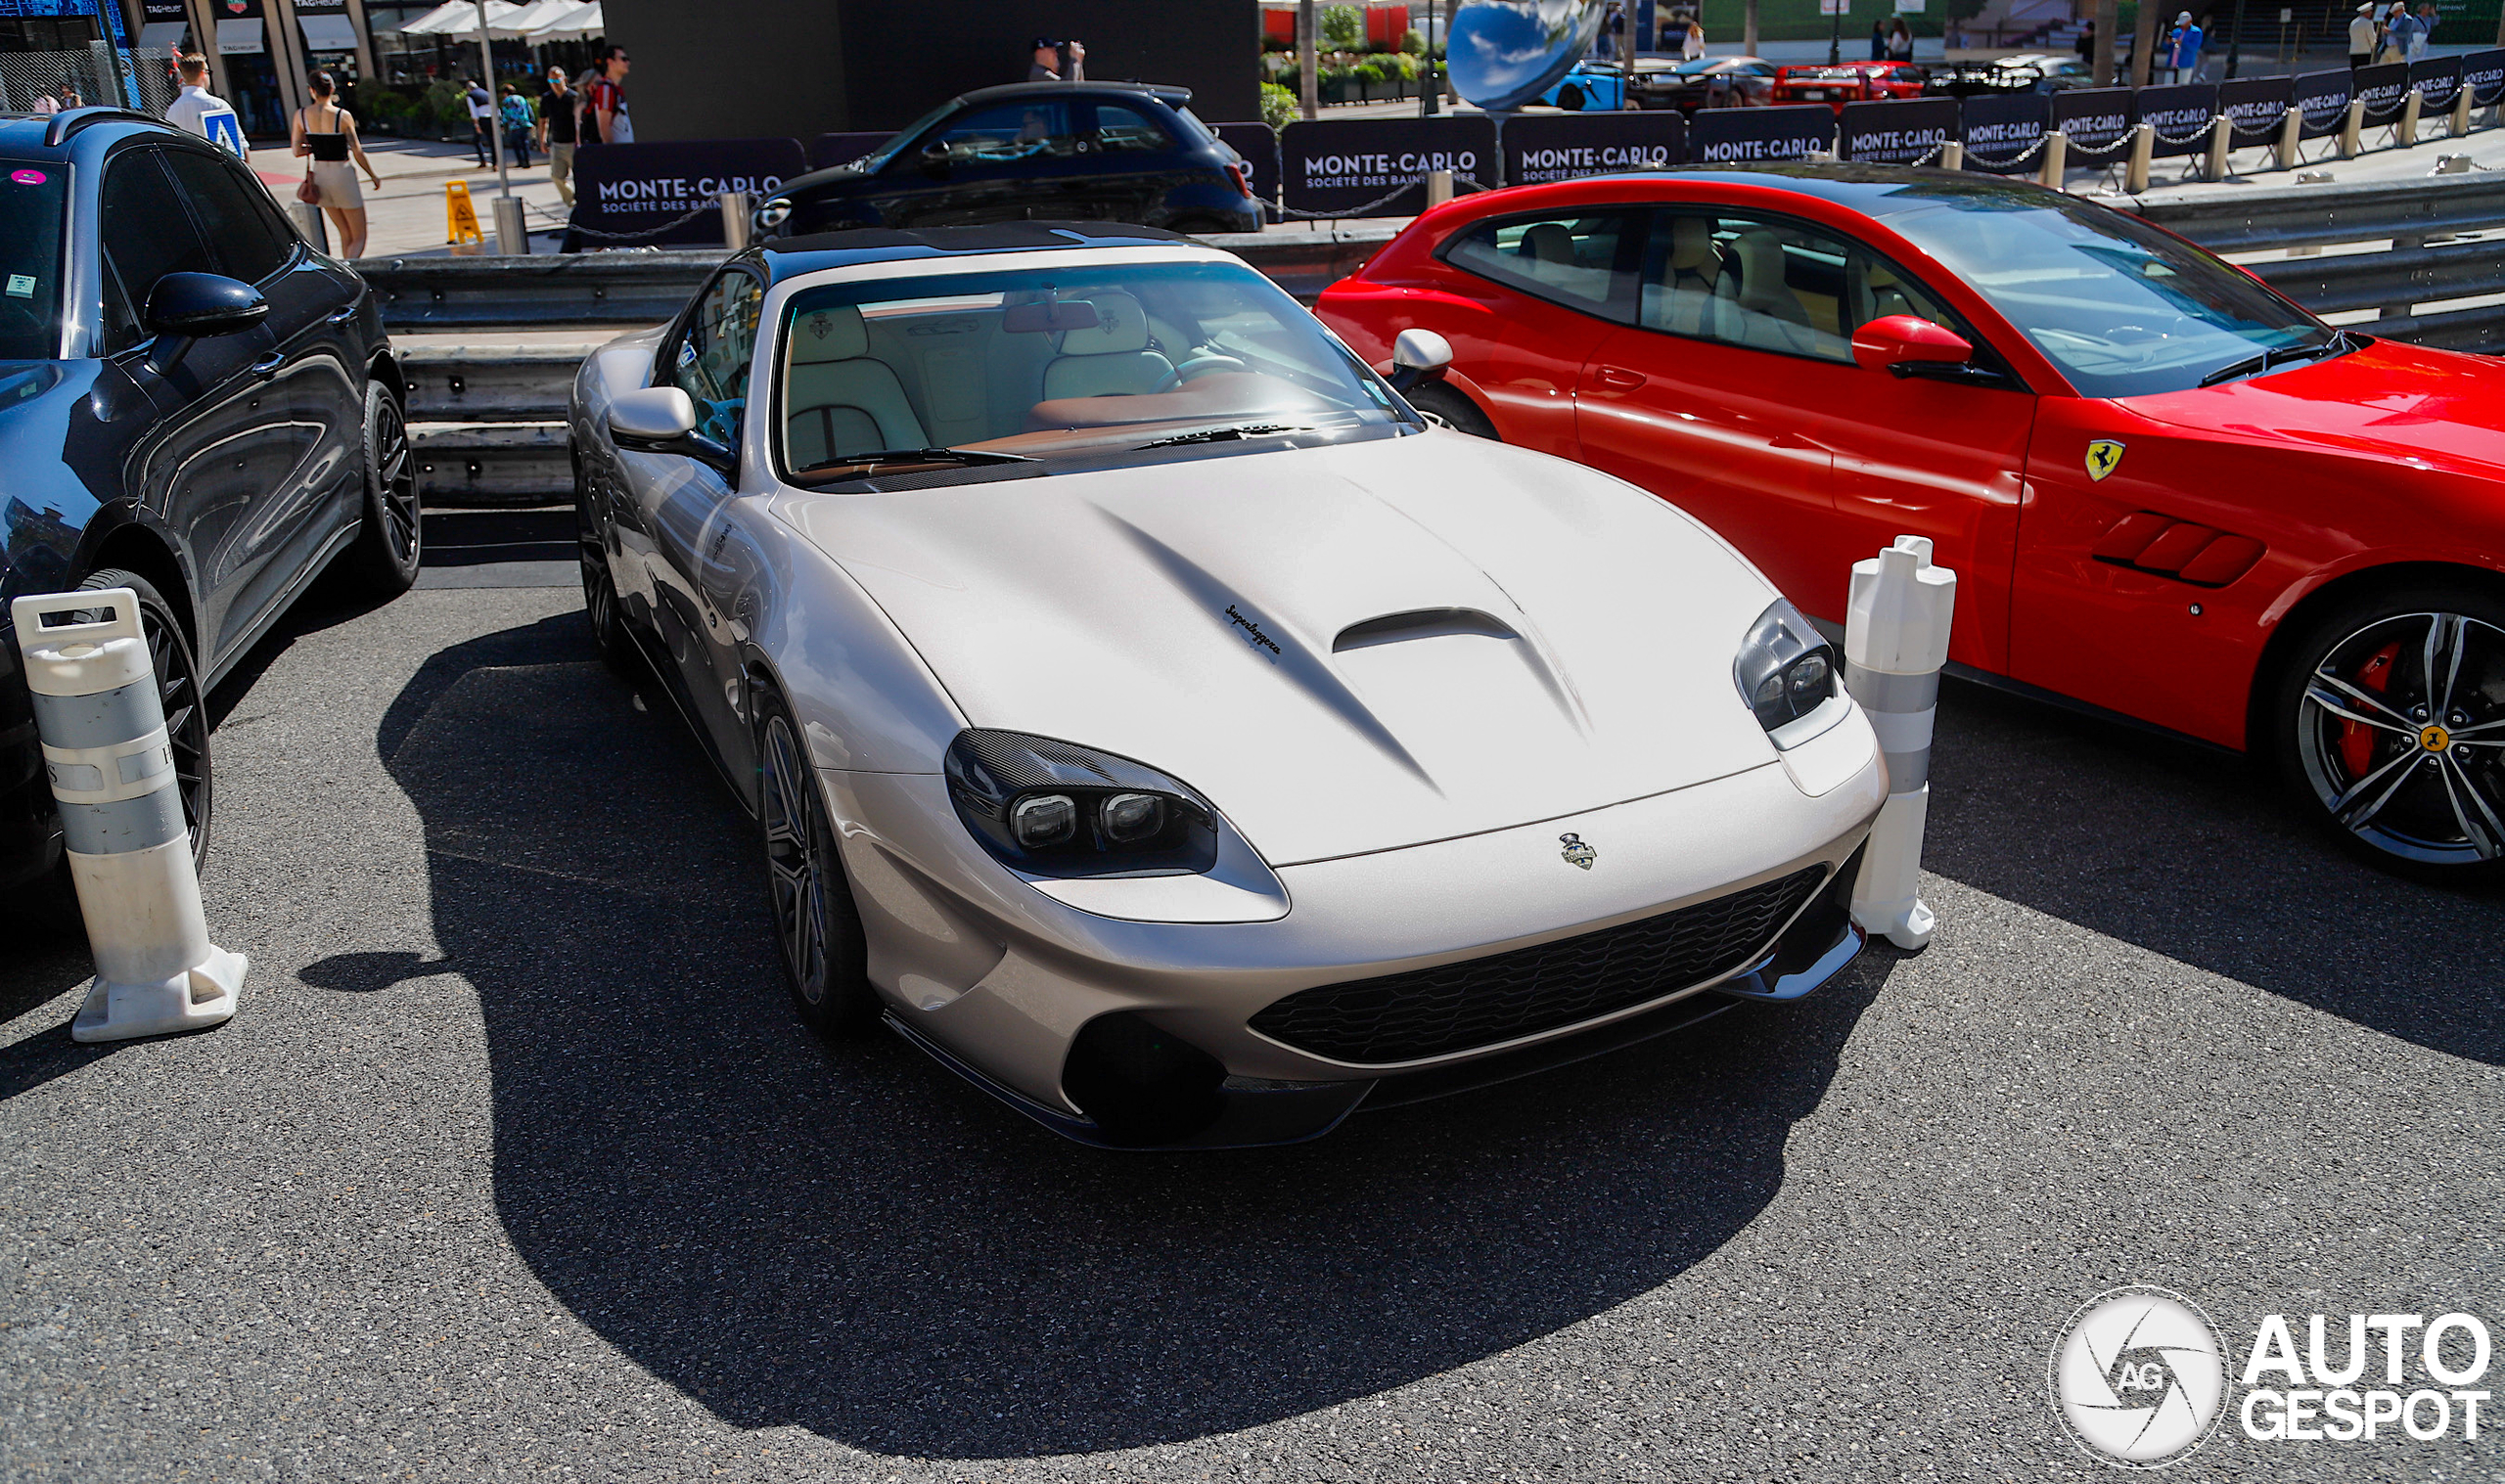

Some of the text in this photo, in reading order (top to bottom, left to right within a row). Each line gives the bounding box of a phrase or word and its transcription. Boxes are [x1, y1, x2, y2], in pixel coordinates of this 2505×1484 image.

[1306, 174, 1359, 189] SOCIÉTÉ
[1363, 175, 1387, 187] DES
[601, 199, 722, 214] SOCIÉTÉ DES BAIN
[1225, 604, 1281, 654] Superleggera
